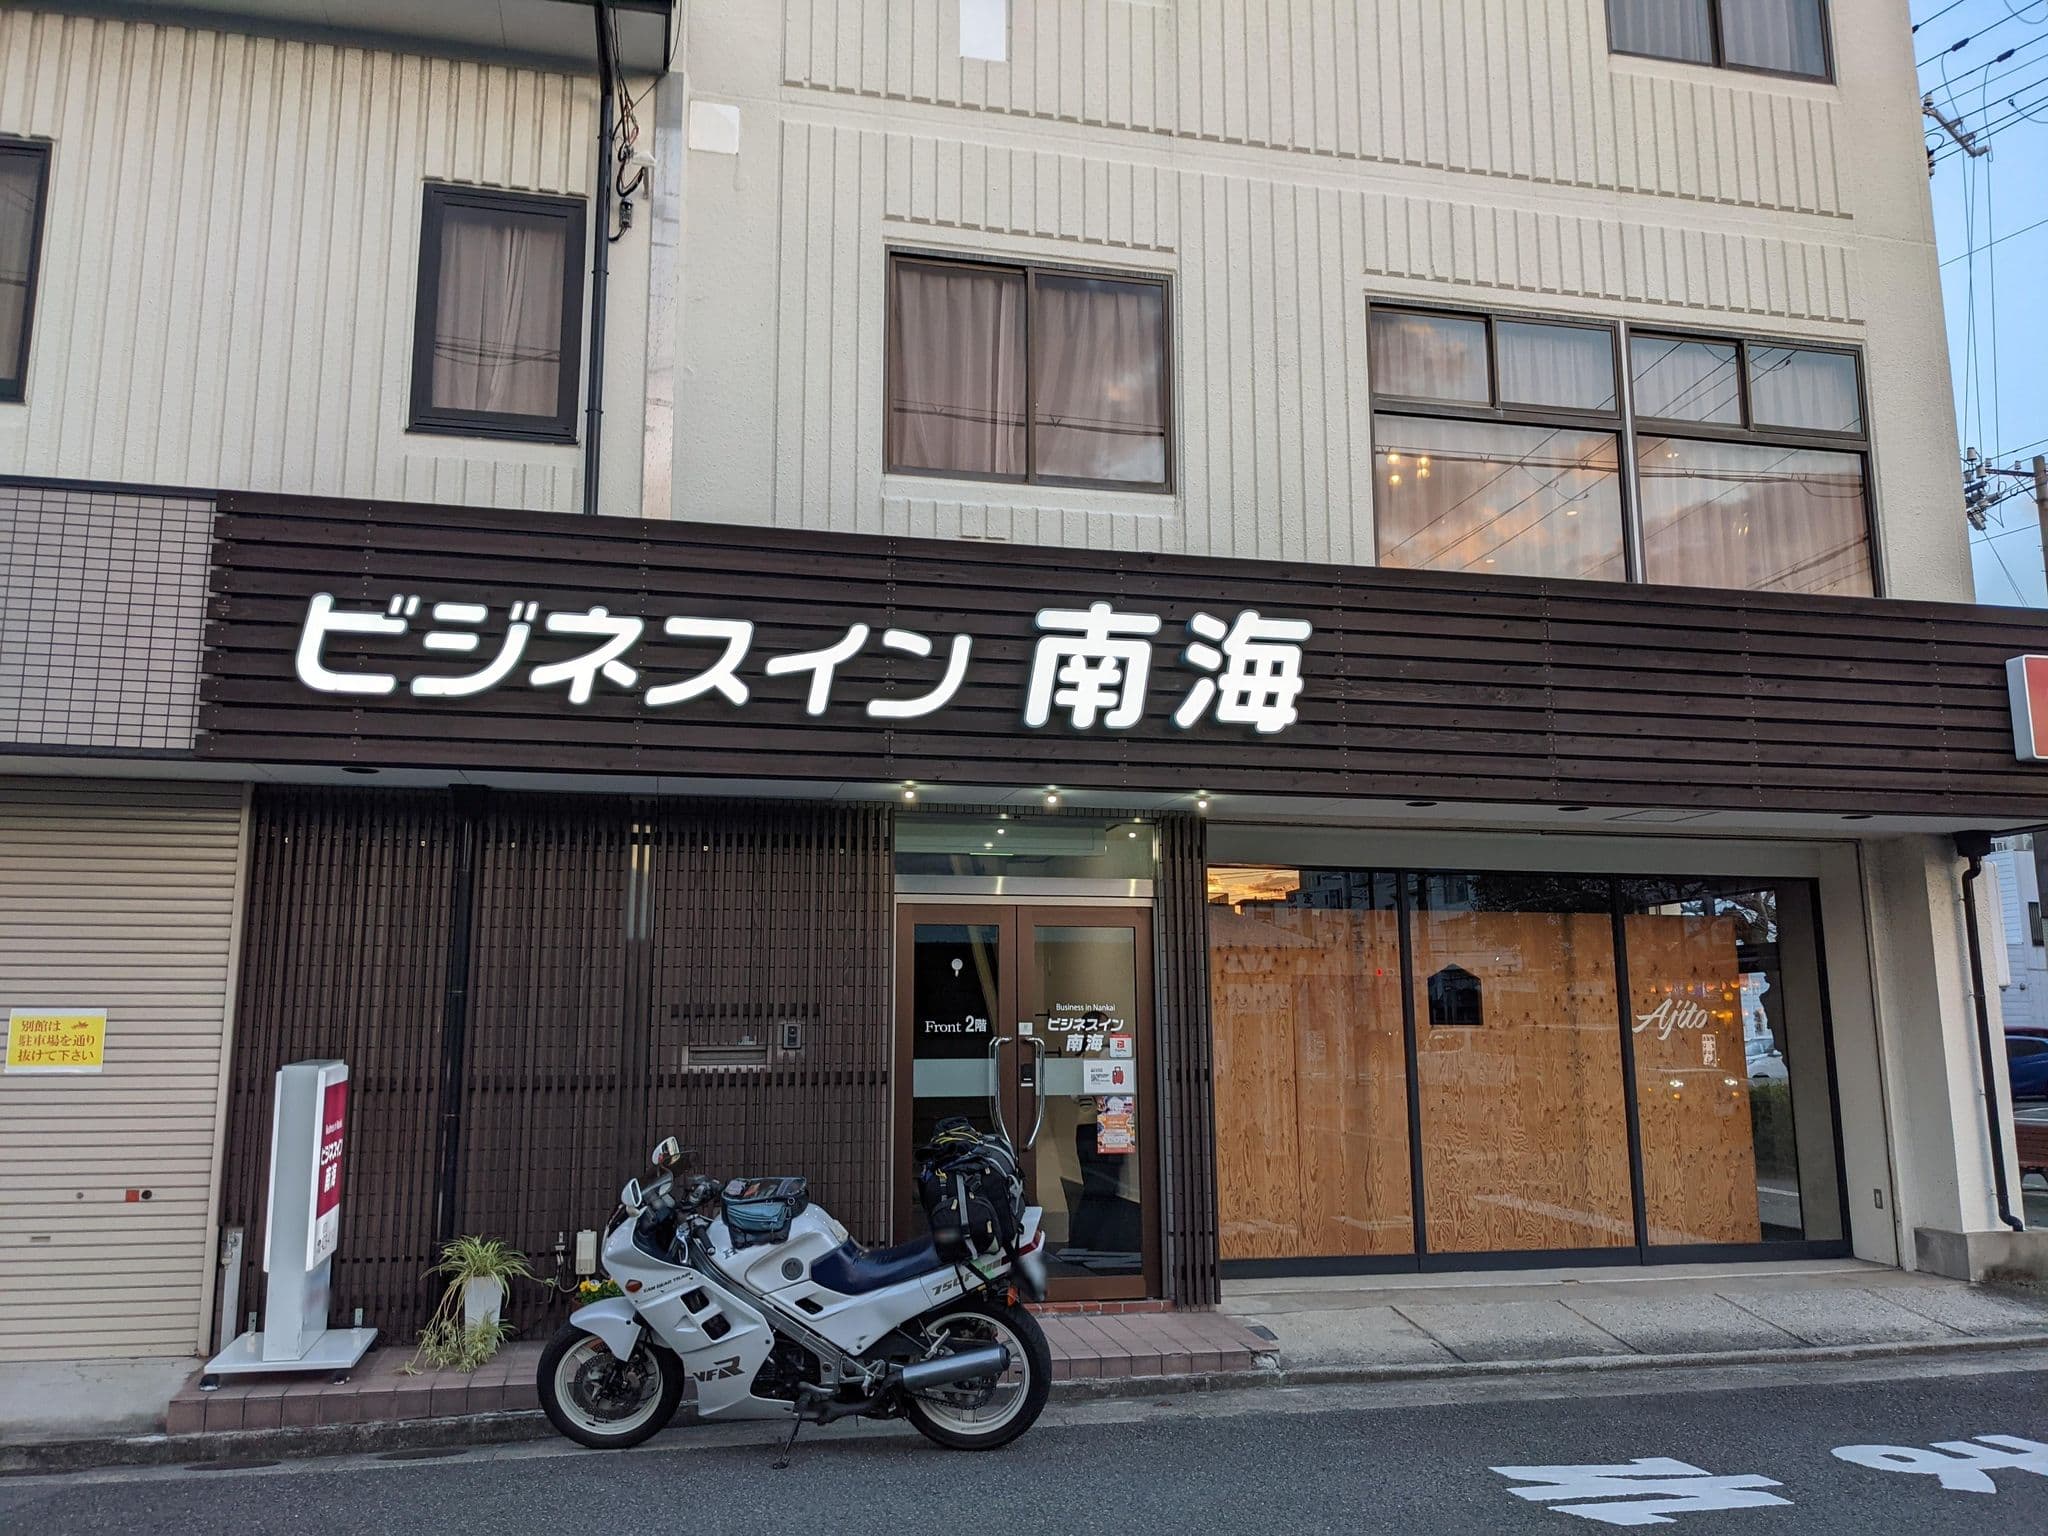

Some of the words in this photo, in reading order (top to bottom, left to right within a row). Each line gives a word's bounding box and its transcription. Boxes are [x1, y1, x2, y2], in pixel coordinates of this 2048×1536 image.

[297, 594, 972, 718] ビジネスイン
[1025, 603, 1311, 733] 南海
[1056, 1003, 1084, 1011] Business
[1093, 1003, 1116, 1011] Nankai
[21, 1020, 61, 1033] 別館は
[924, 1020, 962, 1033] Front
[965, 1014, 987, 1033] 2階
[1048, 1017, 1124, 1032] ビジネスイン
[1632, 998, 1708, 1041] Ajito
[18, 1034, 95, 1048] 駐車場を通り
[1066, 1033, 1104, 1052] 南海
[17, 1049, 95, 1062] 抜けて下さい
[692, 1355, 746, 1382] VFR
